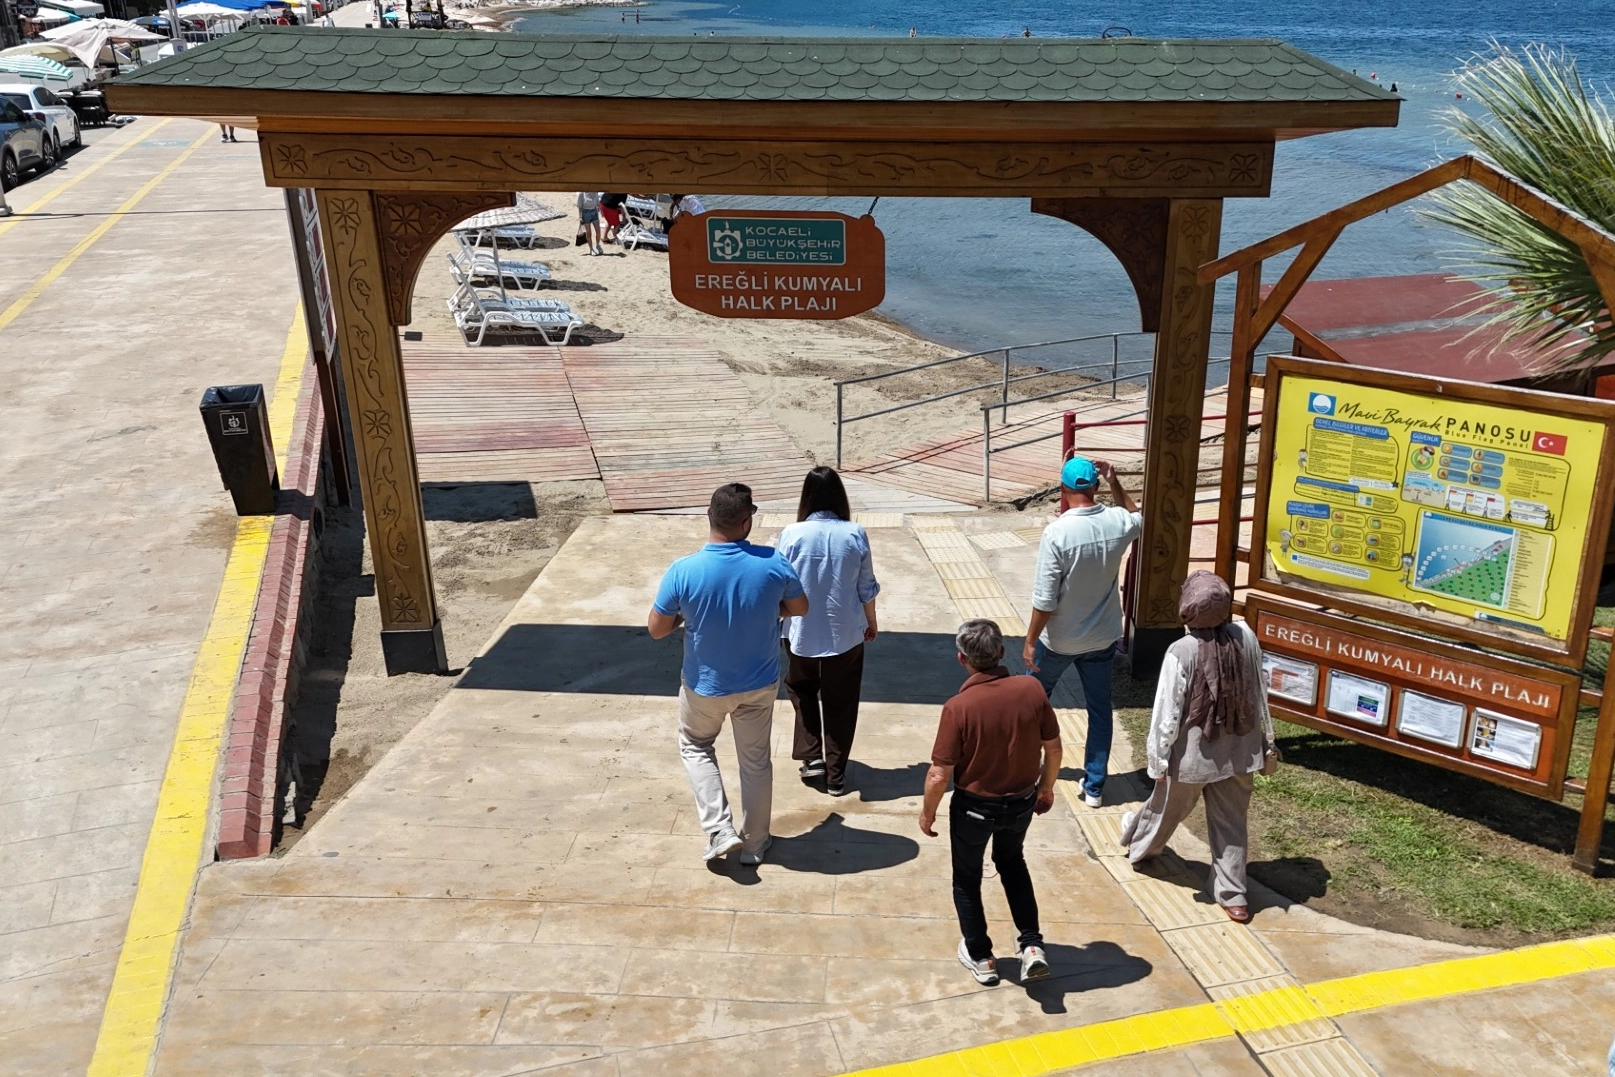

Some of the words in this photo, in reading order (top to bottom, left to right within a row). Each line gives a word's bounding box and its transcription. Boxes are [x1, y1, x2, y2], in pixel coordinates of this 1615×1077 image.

[695, 271, 768, 290] EREĞLİ
[774, 276, 862, 292] KUMYALI
[721, 295, 775, 310] HALK
[781, 296, 837, 311] PLAJI
[1338, 402, 1382, 420] Mavi
[1380, 408, 1443, 432] Bayrak
[1446, 417, 1531, 442] PANOSU
[1265, 623, 1331, 651] EREĞLİ
[1337, 642, 1422, 676] KUMYALI
[1430, 666, 1483, 691] HALK
[1491, 681, 1550, 709] PLAJI
